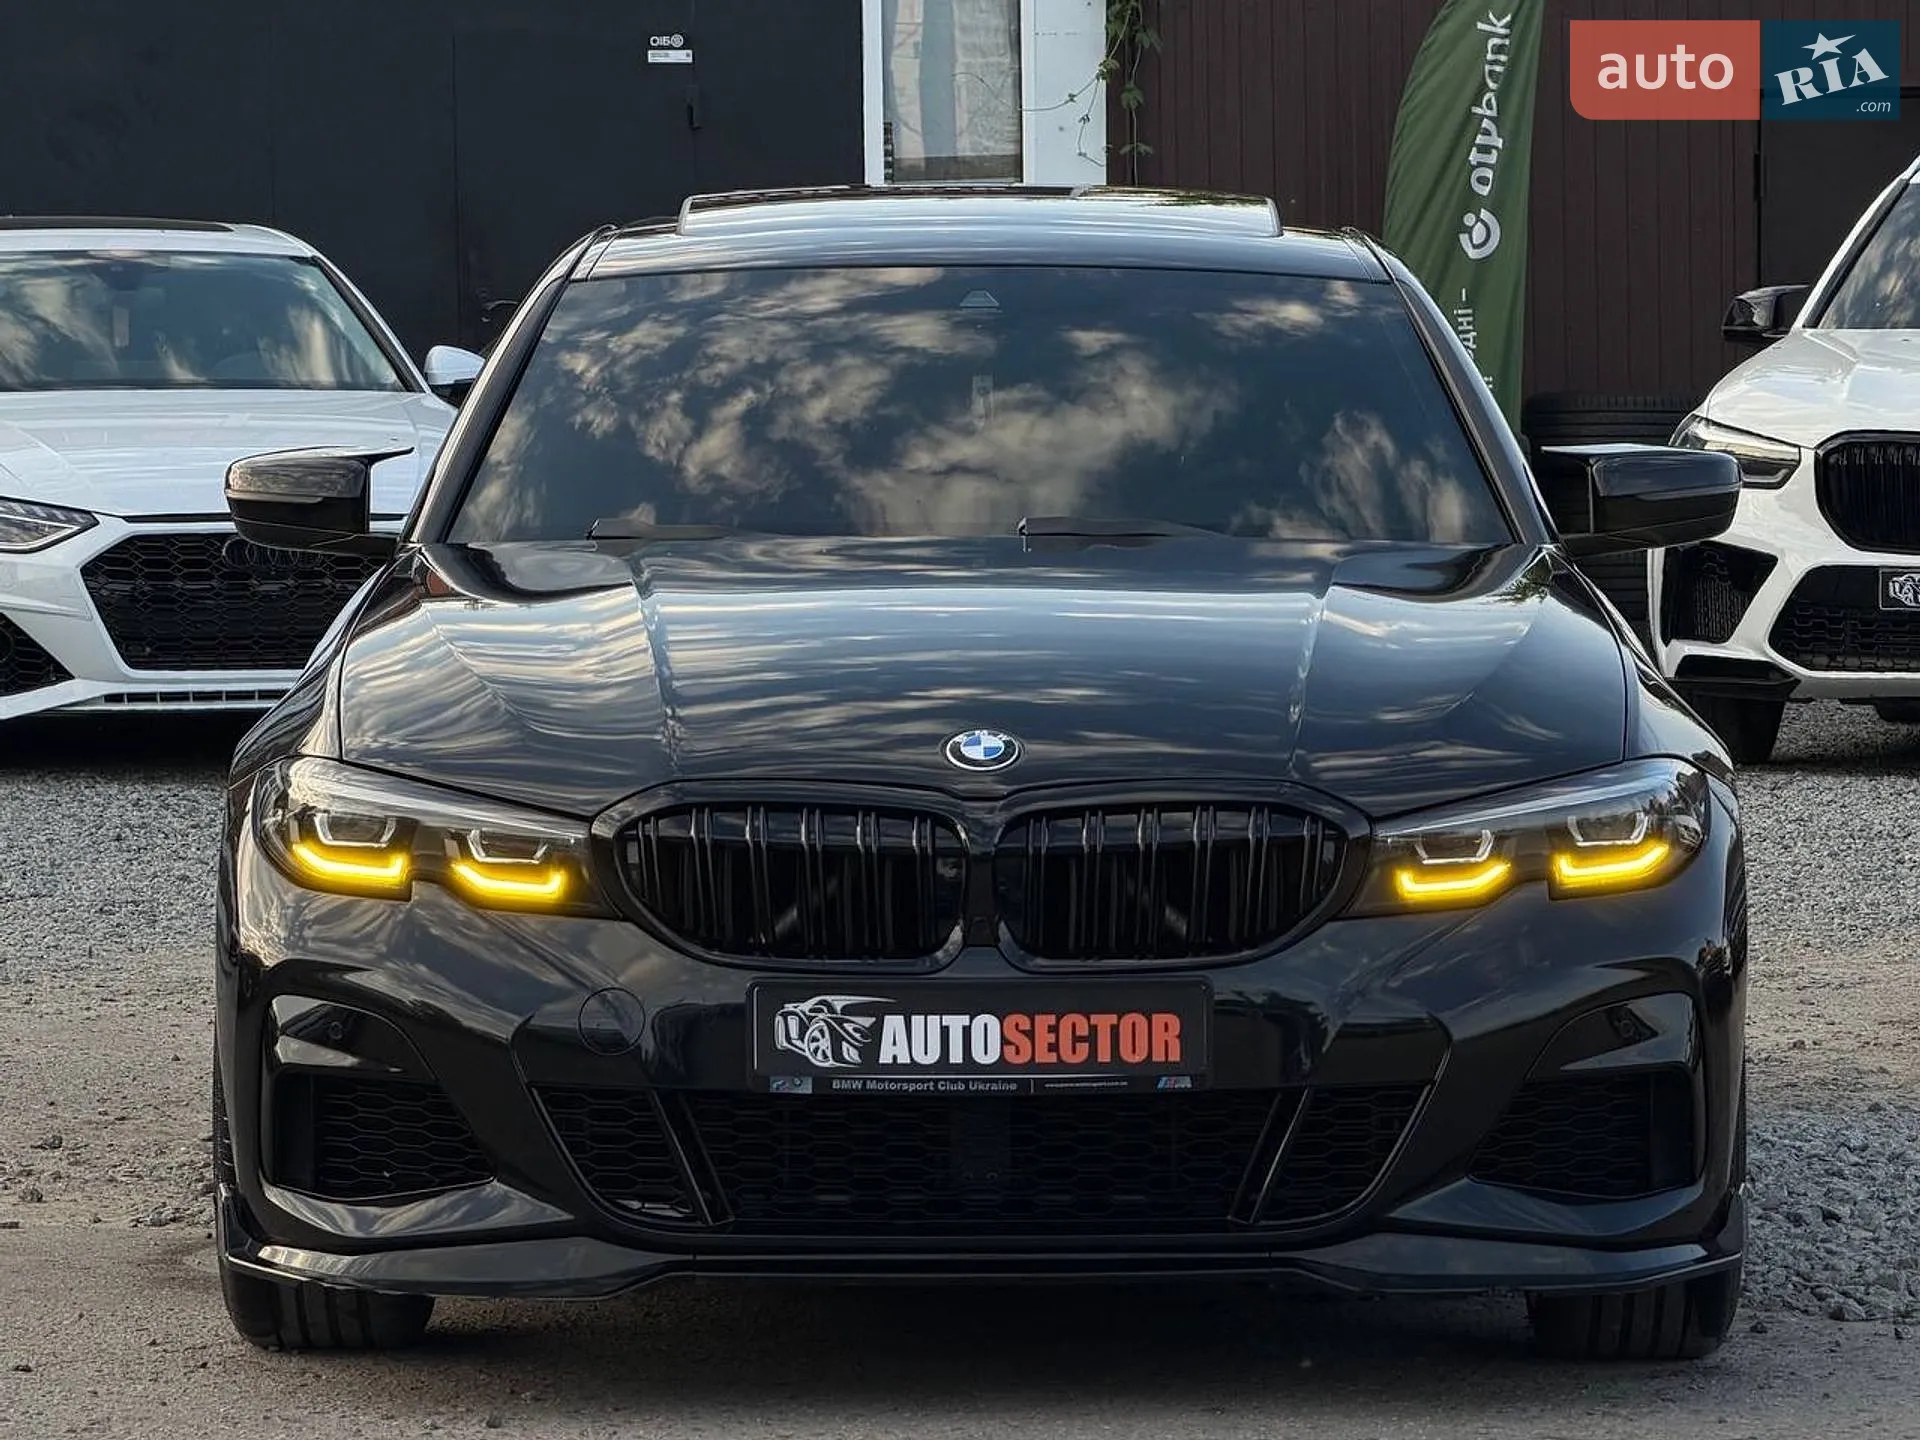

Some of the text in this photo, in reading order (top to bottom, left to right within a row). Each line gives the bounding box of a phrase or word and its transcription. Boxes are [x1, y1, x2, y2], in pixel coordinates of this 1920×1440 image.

[1468, 9, 1513, 197] otpbank
[879, 1013, 1181, 1065] AUTOSECTOR
[832, 1079, 1018, 1092] BMW Motorsport Club Ukraine
